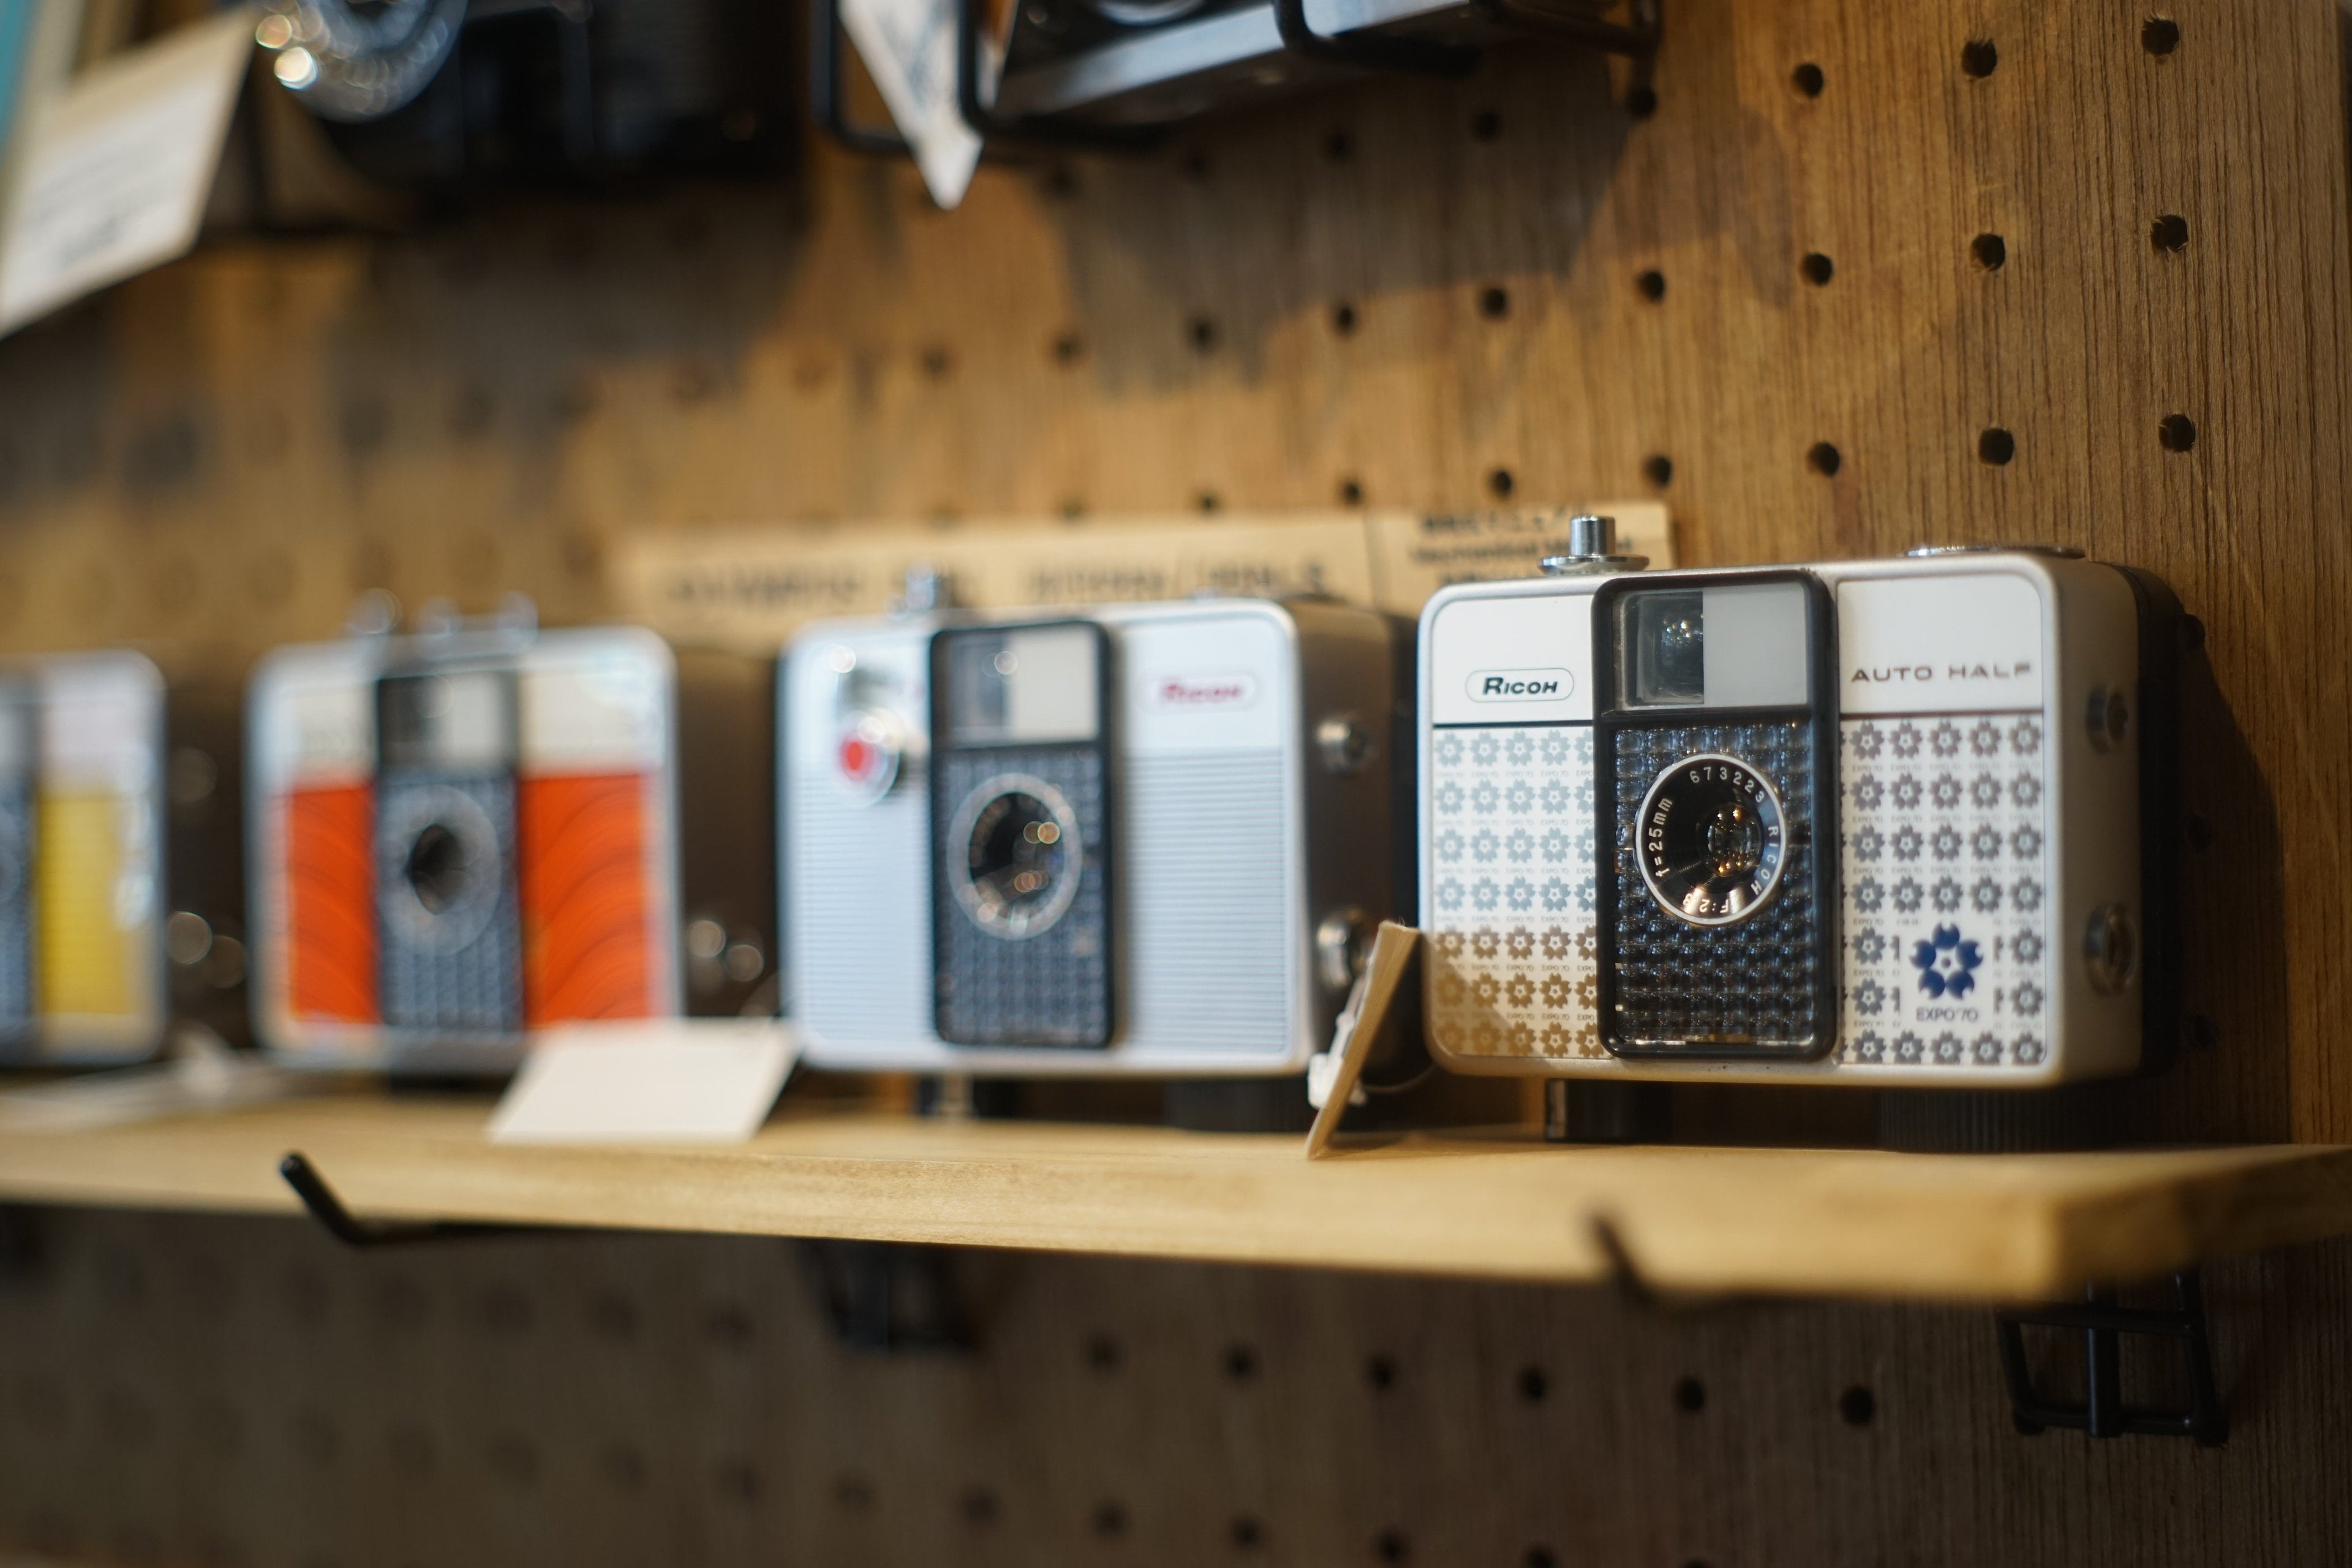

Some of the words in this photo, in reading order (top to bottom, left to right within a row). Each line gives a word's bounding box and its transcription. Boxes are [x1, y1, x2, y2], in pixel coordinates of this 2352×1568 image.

[1851, 665, 1933, 682] AUTO
[1948, 662, 2030, 680] HALF
[1482, 677, 1558, 695] RICOH
[1689, 766, 1765, 803] 673223
[1648, 797, 1673, 877] f=25mm
[1751, 826, 1779, 895] RICOH
[1683, 893, 1728, 913] F:28
[1916, 1007, 1979, 1022] EXPO'70
